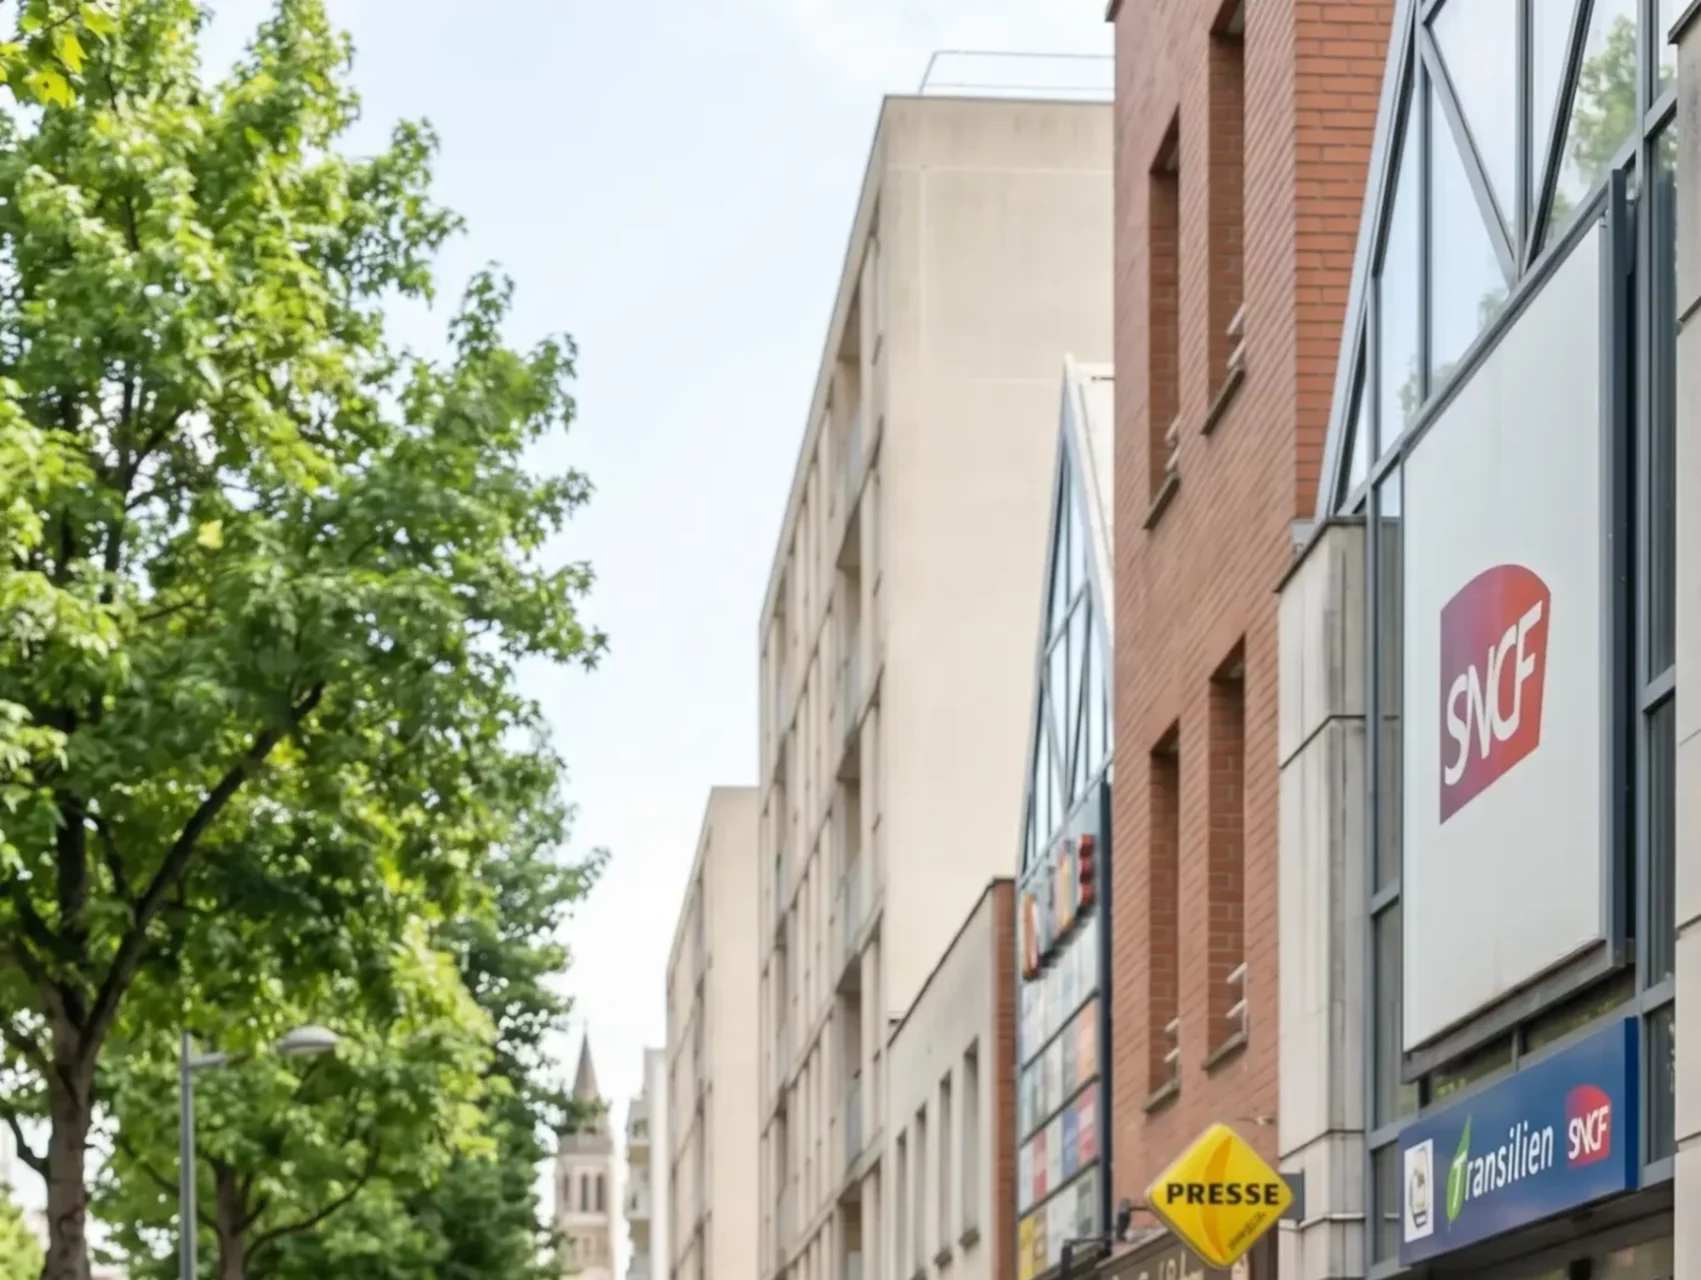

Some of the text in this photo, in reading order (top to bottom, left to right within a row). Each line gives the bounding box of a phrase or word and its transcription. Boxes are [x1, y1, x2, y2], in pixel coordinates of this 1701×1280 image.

[1444, 599, 1543, 786] SNCF
[1166, 1181, 1280, 1206] PRESSE
[1452, 1104, 1610, 1209] Transilien SNCF
